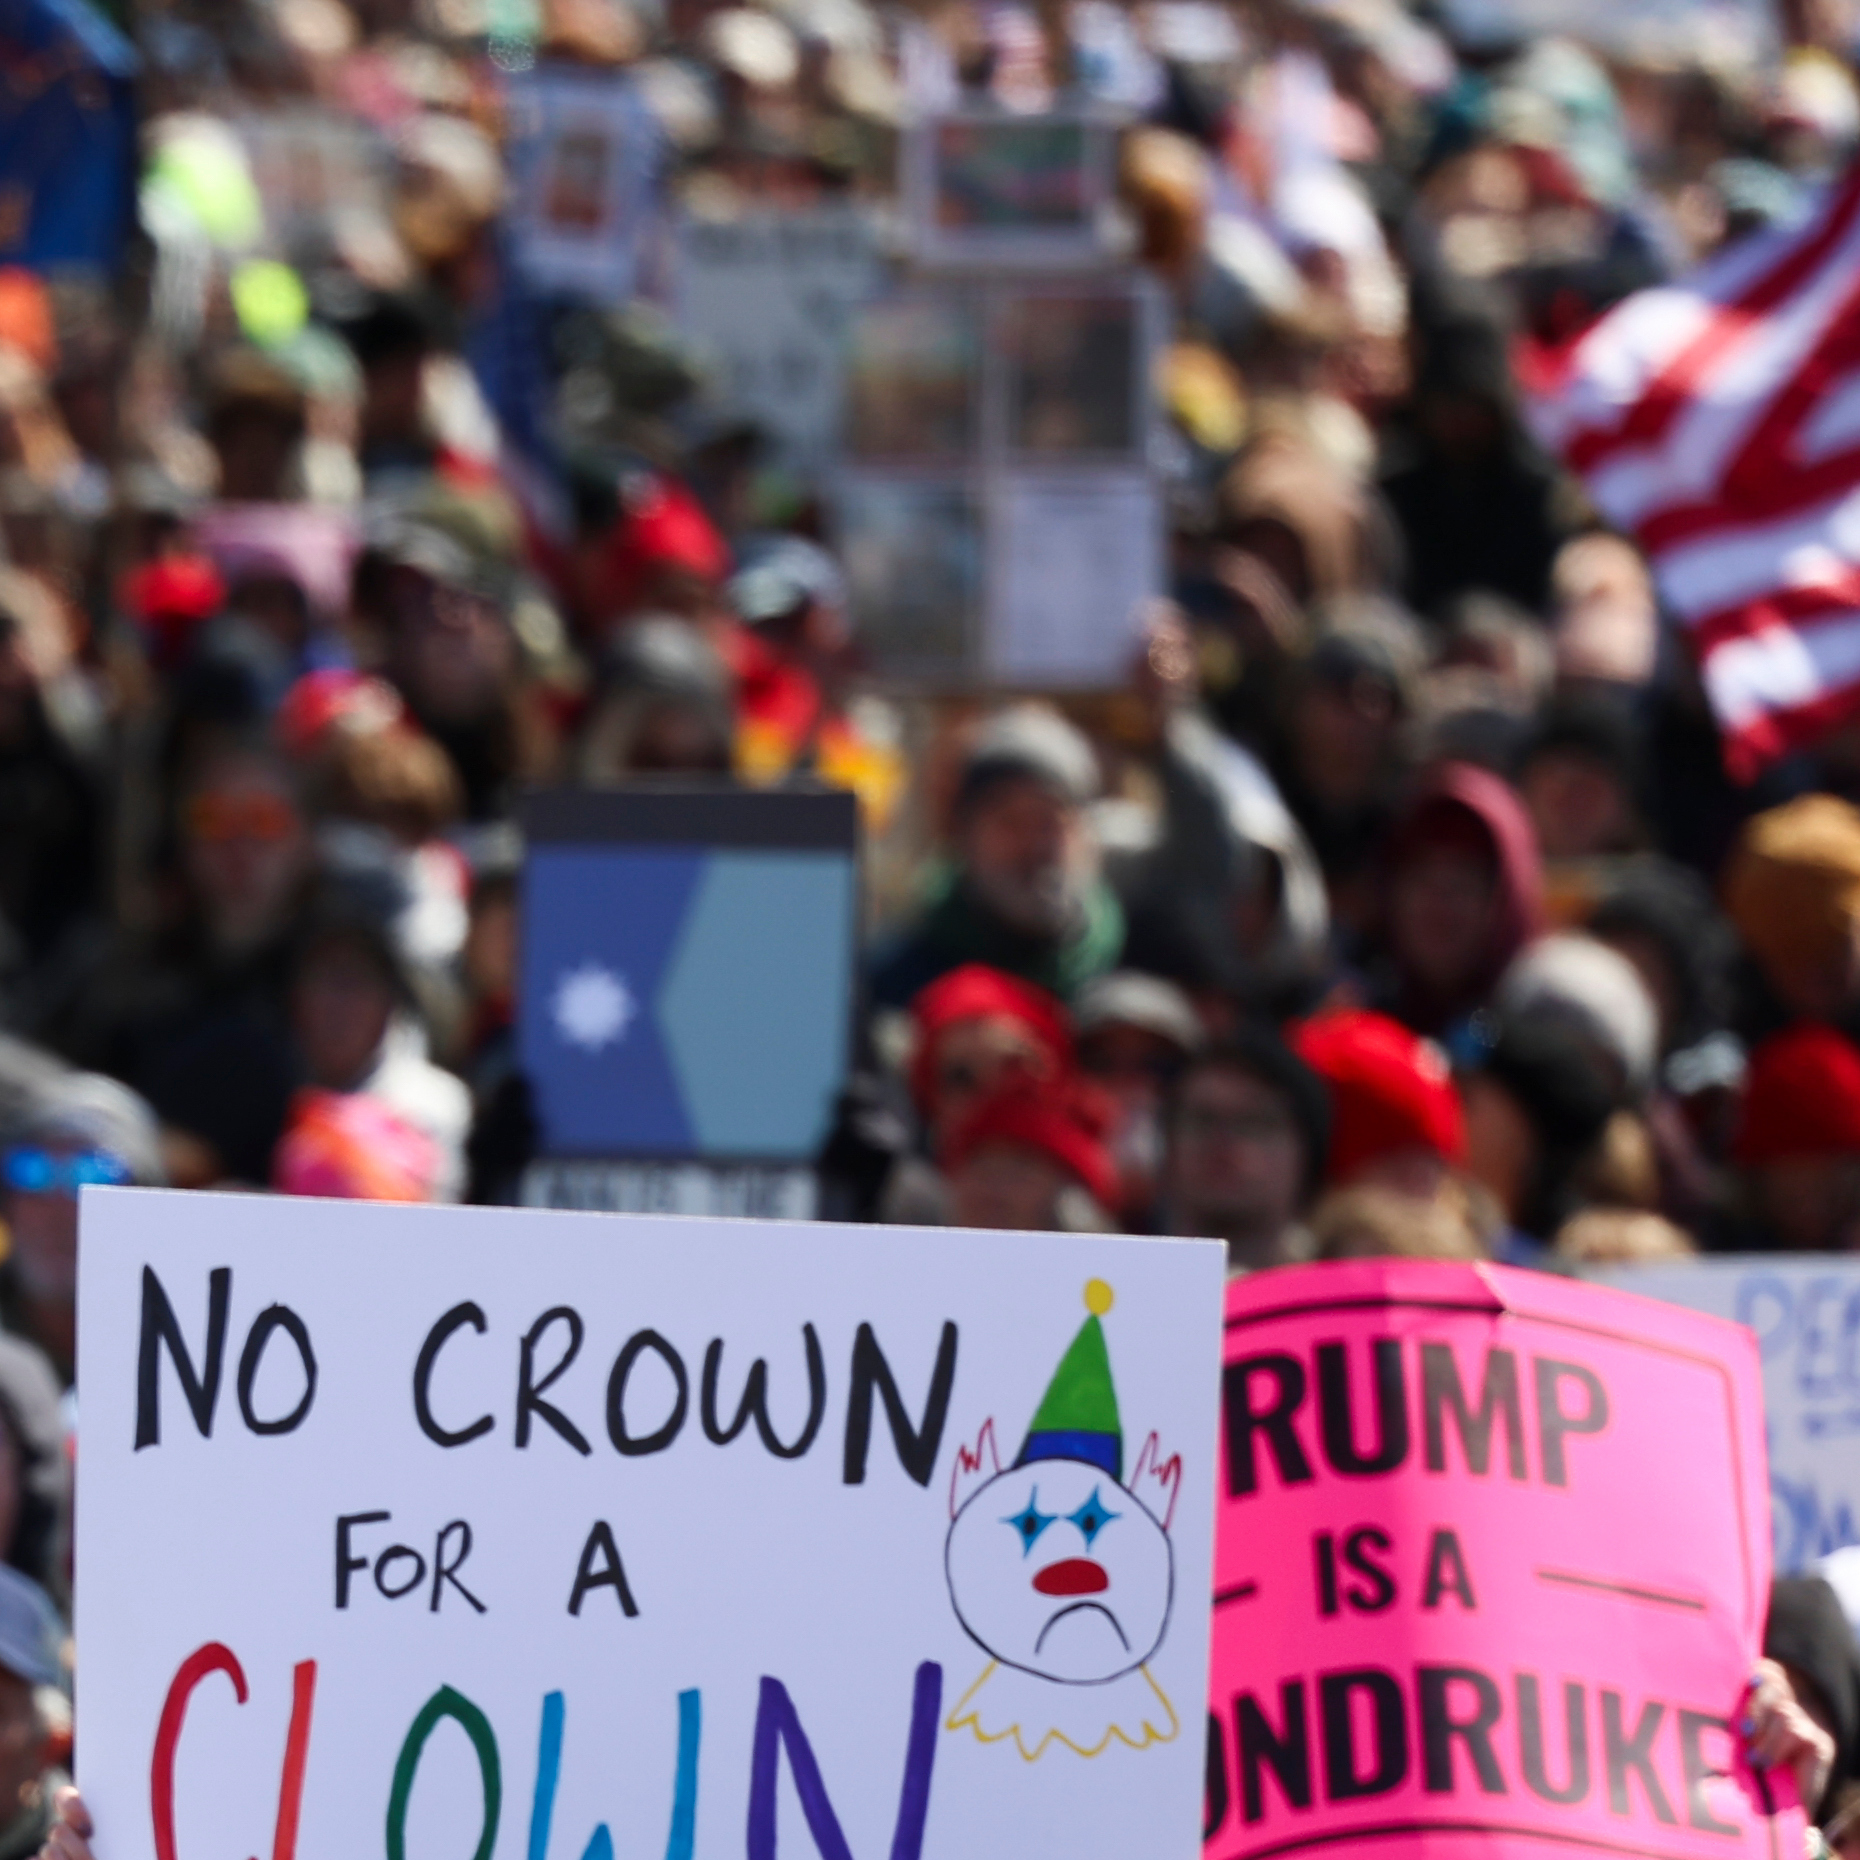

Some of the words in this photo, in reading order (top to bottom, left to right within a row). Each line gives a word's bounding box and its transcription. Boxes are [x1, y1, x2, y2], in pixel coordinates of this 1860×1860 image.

[133, 1264, 317, 1452] NO
[414, 1302, 957, 1487] CROWN
[1222, 1334, 1611, 1501] RUMP
[567, 1521, 638, 1618] A
[1314, 1528, 1394, 1620] IS
[1422, 1528, 1475, 1609] A
